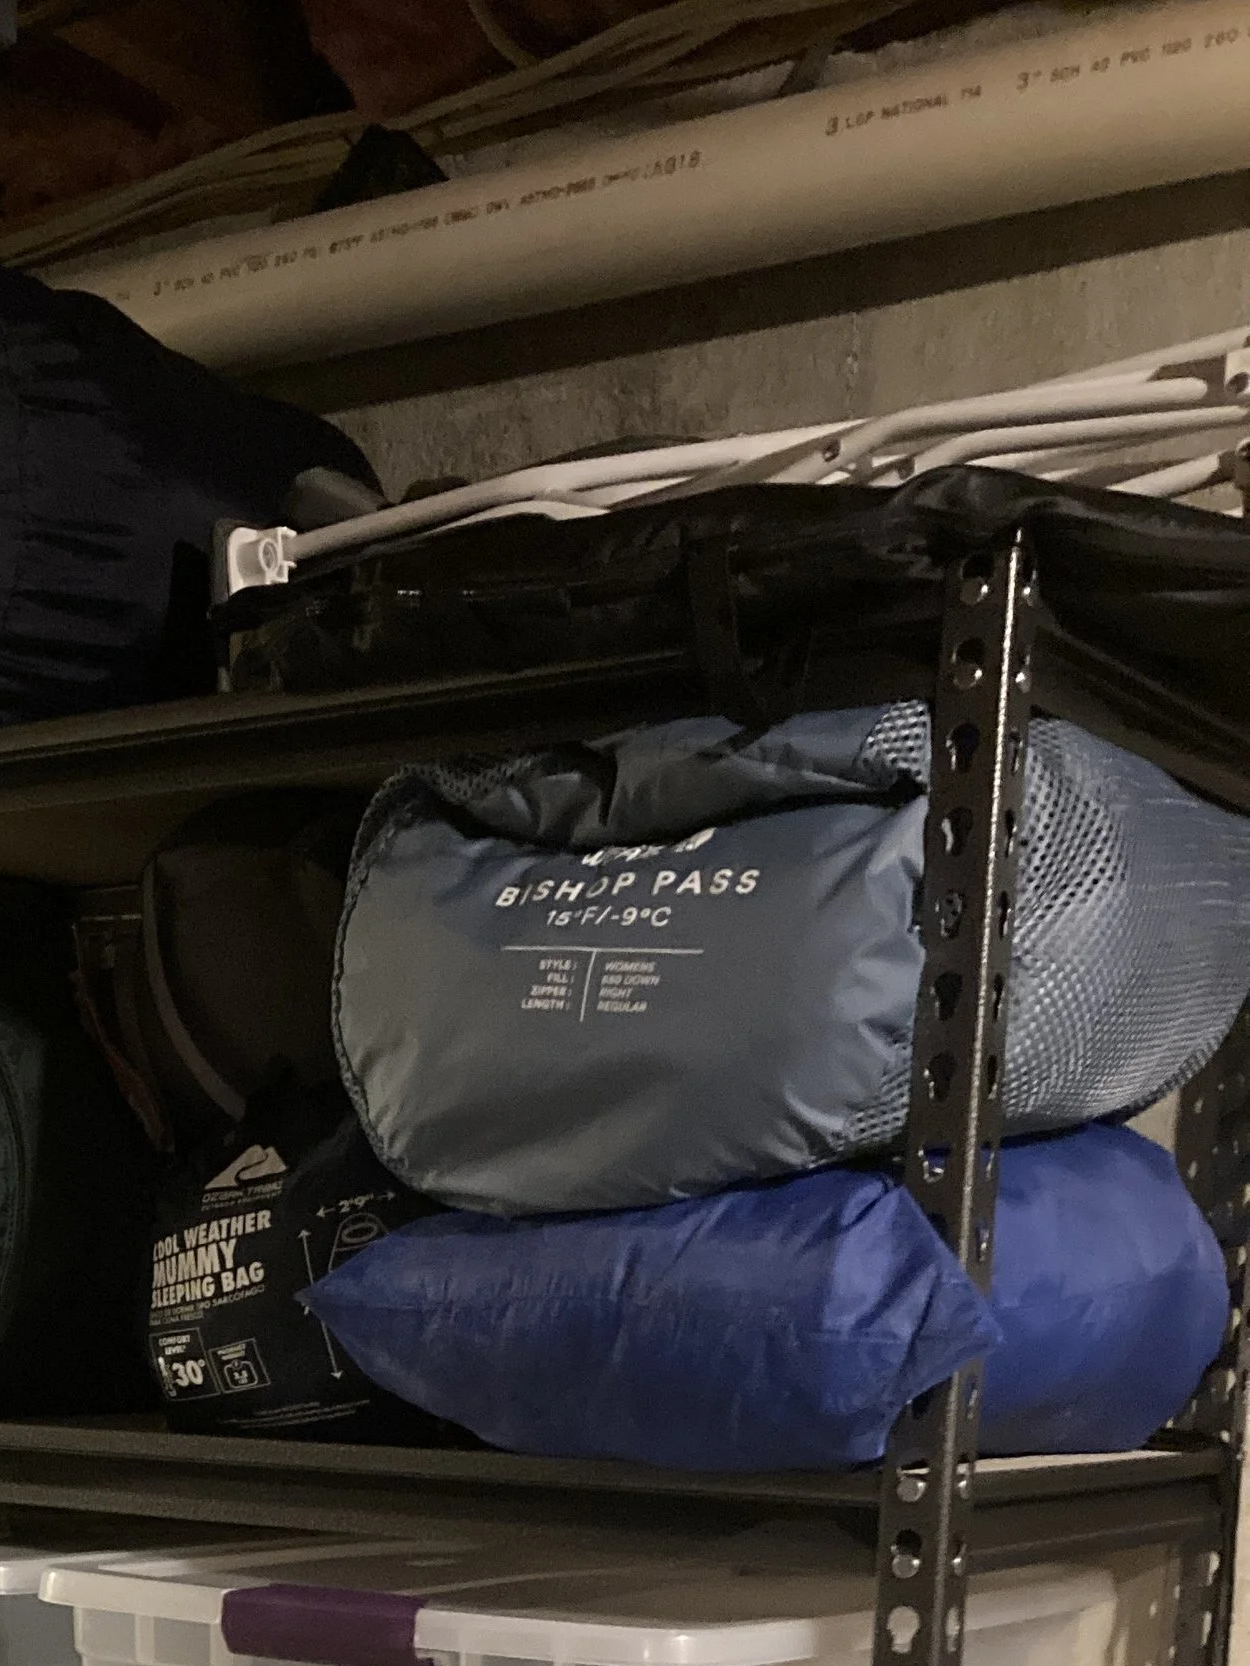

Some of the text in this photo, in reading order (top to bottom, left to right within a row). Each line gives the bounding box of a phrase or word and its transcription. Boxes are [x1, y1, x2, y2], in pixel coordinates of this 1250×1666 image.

[494, 868, 761, 907] BISHOP PASS
[183, 1209, 272, 1249] WEATHER
[150, 1261, 265, 1309] SLEEPING BAG
[152, 1237, 237, 1289] MUMMY
